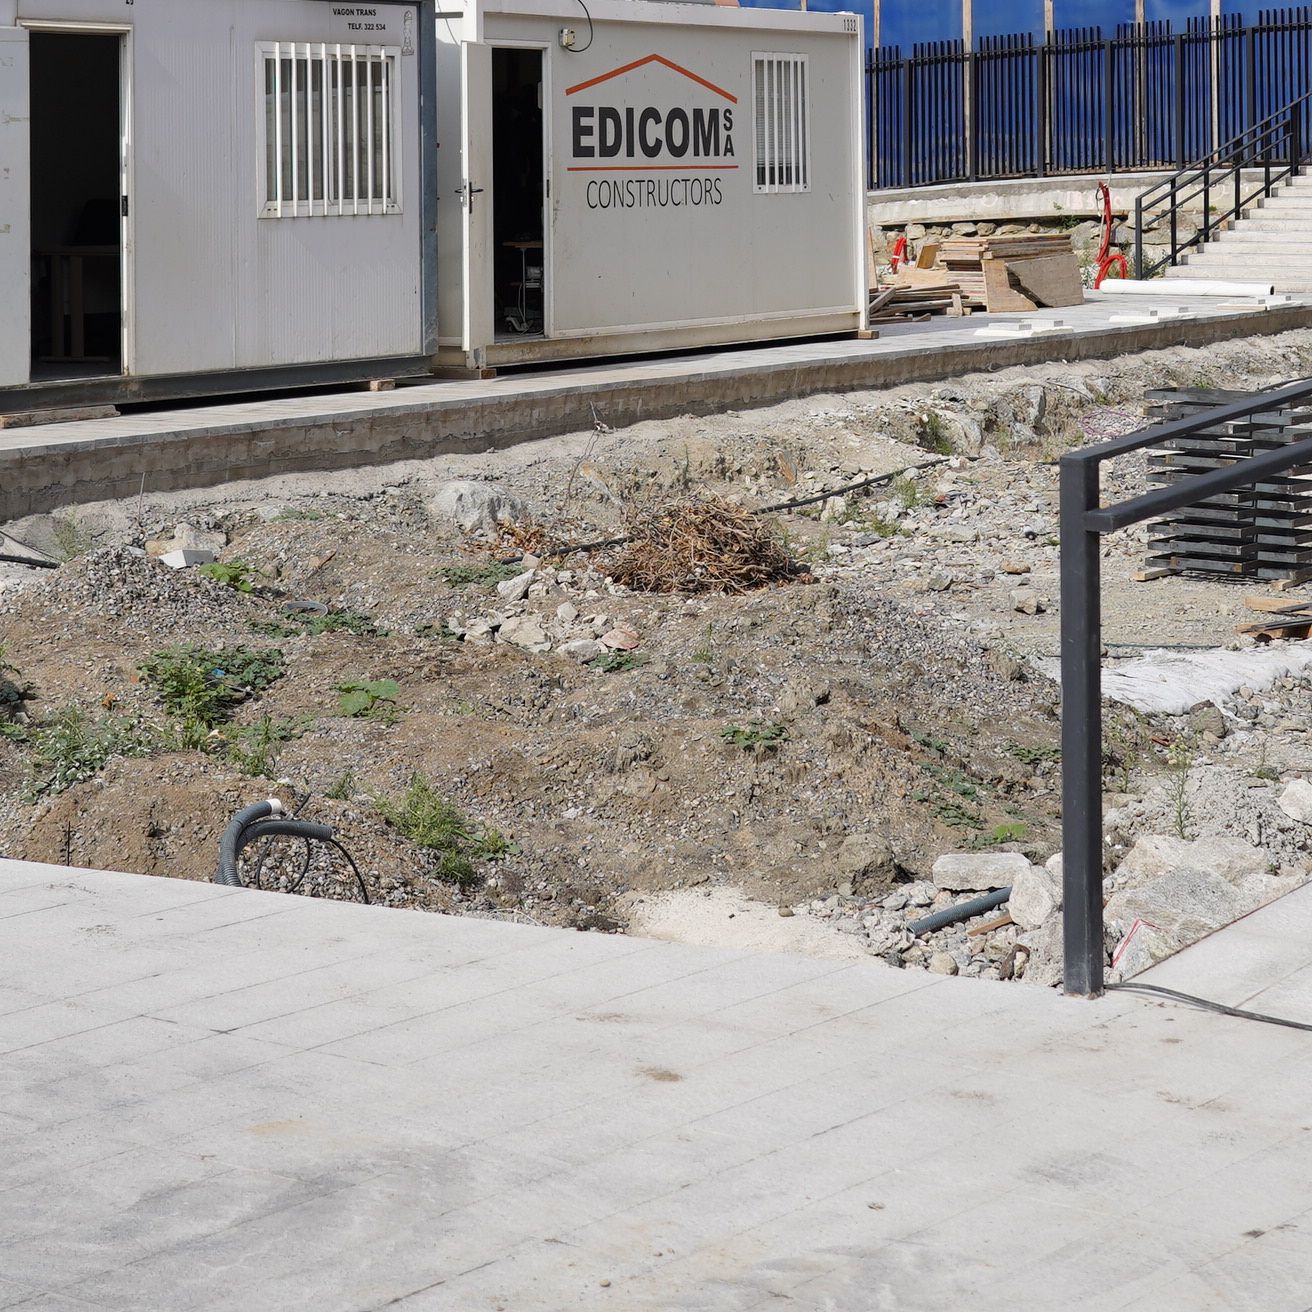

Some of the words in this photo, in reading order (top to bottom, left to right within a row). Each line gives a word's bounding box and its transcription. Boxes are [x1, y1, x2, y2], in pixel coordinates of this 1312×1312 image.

[333, 8, 355, 16] VAGON
[356, 8, 377, 16] TRANS
[364, 23, 375, 31] 322
[376, 23, 386, 31] 534
[572, 106, 720, 158] EDICOM
[586, 177, 723, 209] CONSTRUCTORS
